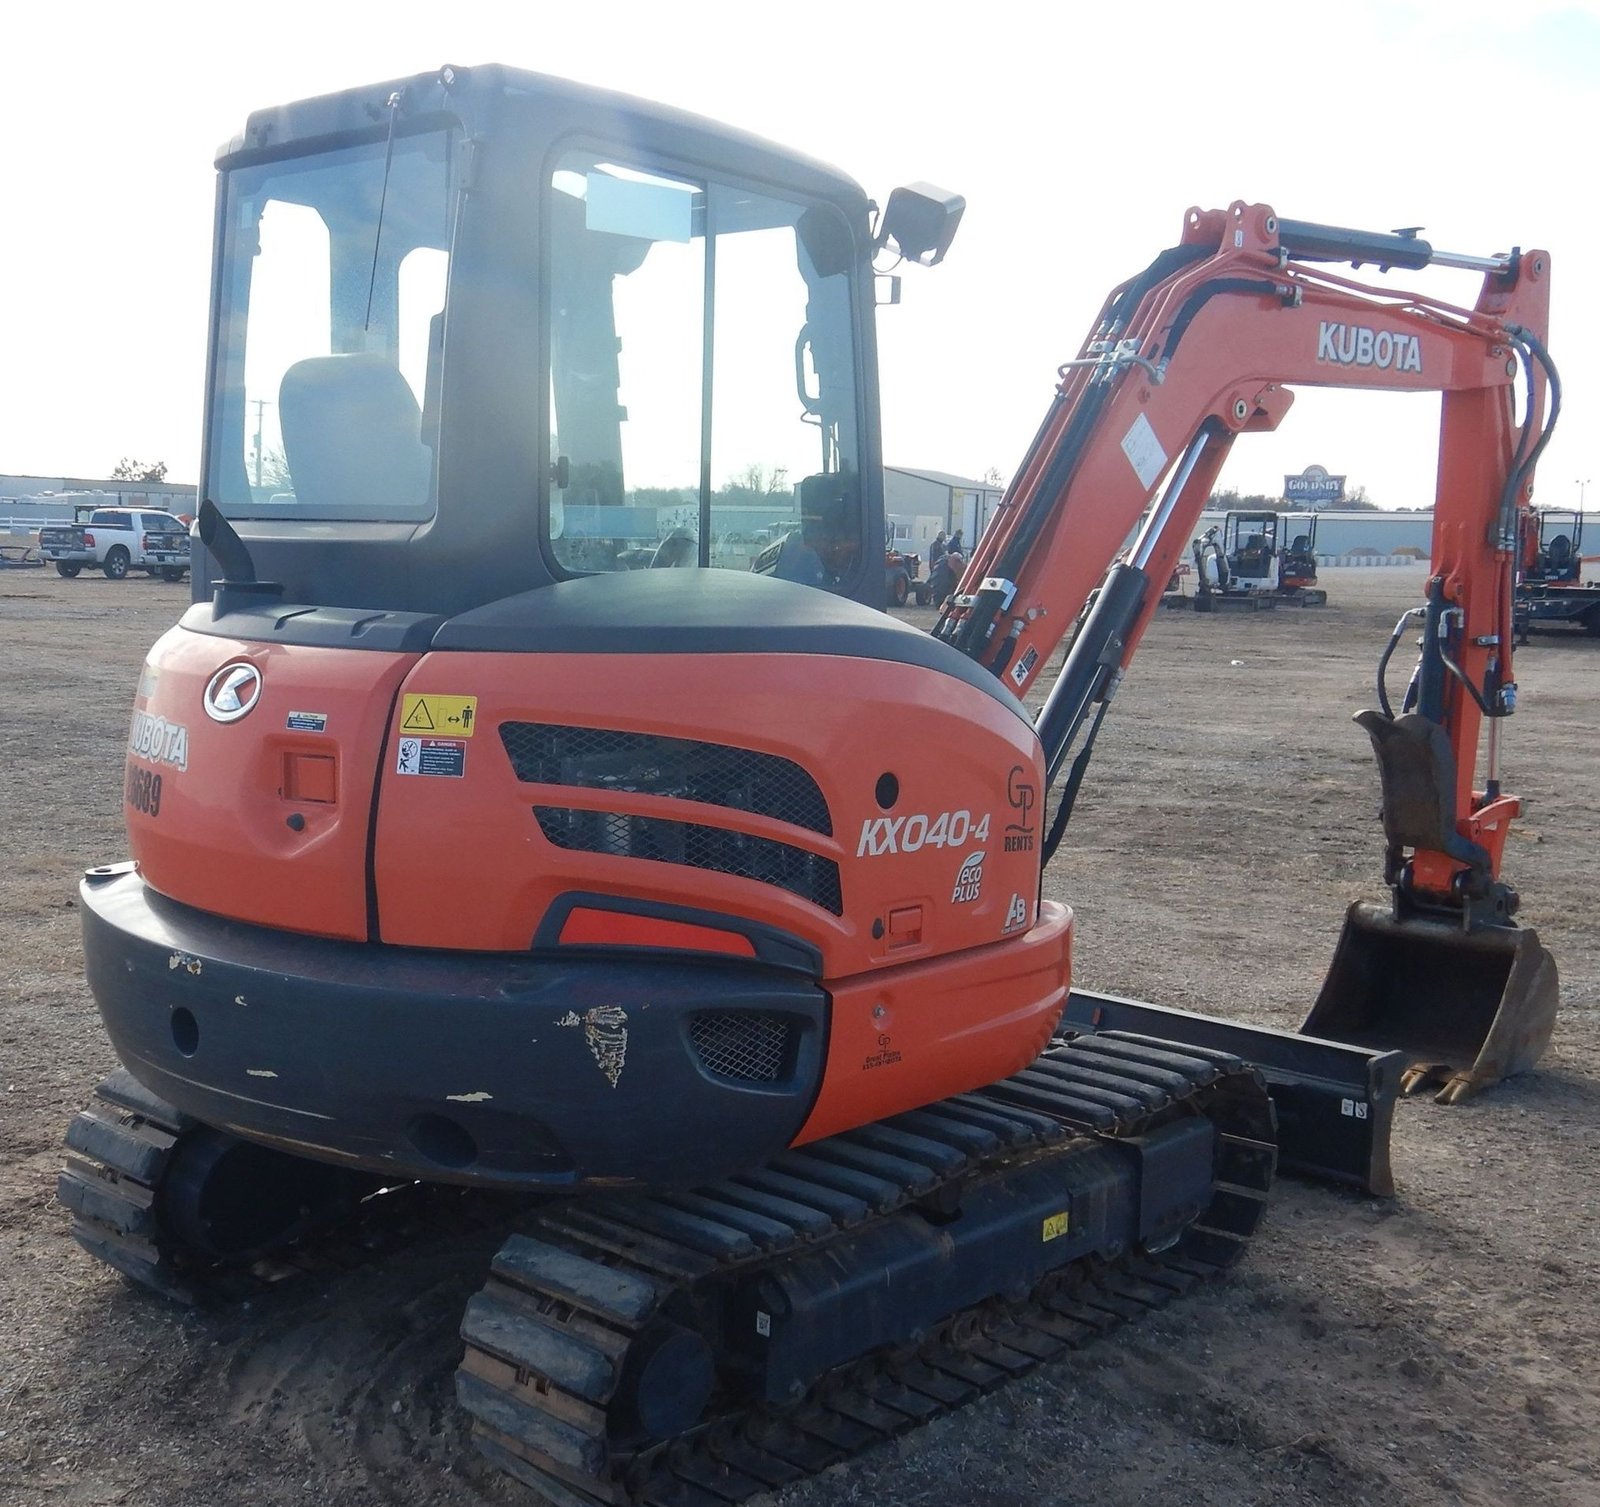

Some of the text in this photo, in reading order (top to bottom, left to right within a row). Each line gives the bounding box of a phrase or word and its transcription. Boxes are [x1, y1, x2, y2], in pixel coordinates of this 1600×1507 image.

[1318, 321, 1422, 373] KUBOTA
[131, 714, 188, 766] UBOTA
[856, 810, 991, 858] KX040-4
[1004, 836, 1034, 852] RENTS
[961, 866, 982, 885] eco
[952, 883, 980, 904] PLUS
